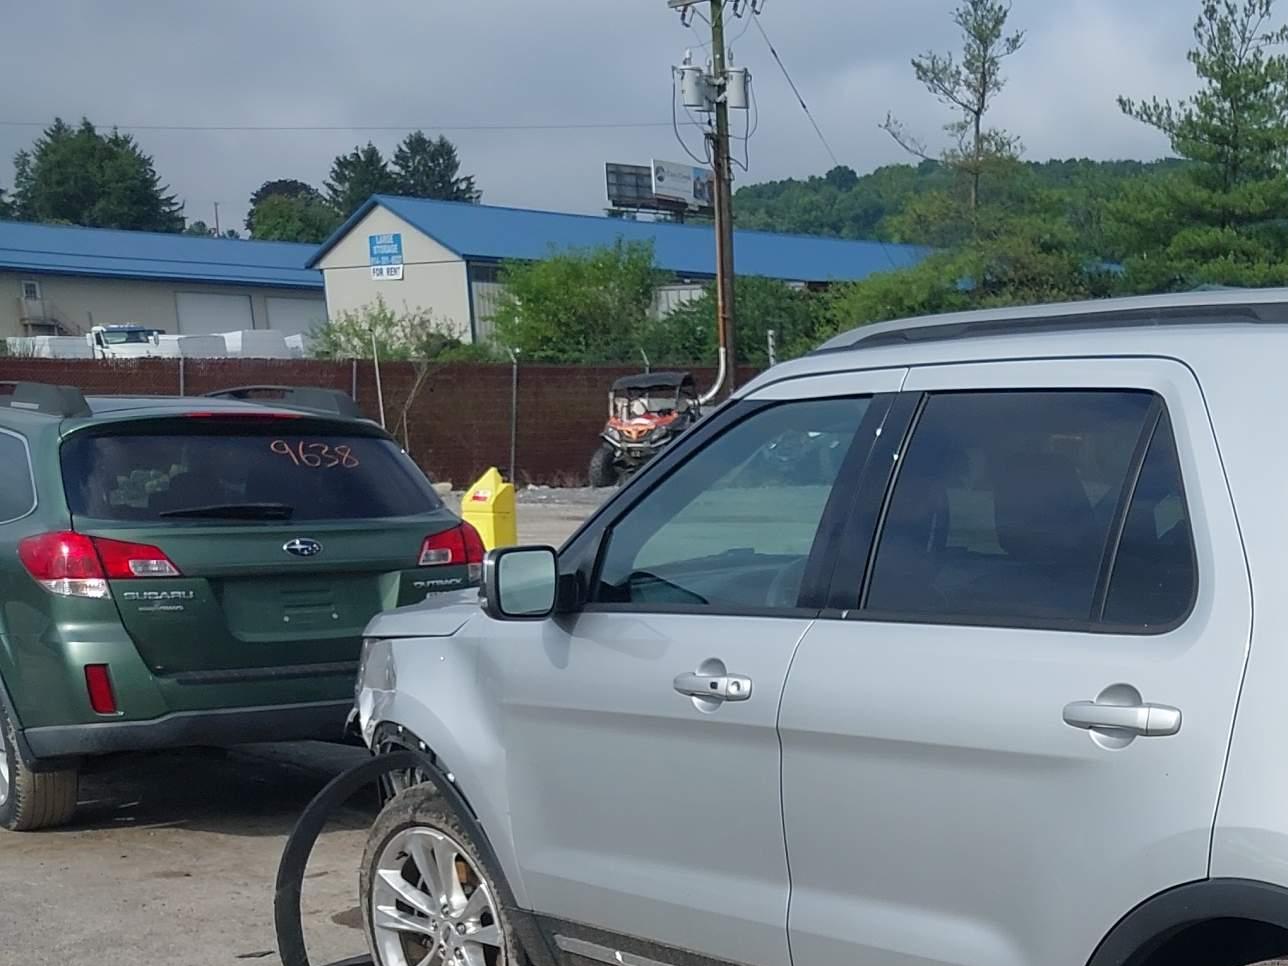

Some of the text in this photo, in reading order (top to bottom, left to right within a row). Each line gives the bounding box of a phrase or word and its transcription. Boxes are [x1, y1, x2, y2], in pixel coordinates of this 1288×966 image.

[372, 266, 401, 277] FOR RENT
[270, 440, 359, 468] 9638
[123, 591, 194, 600] SUBARU
